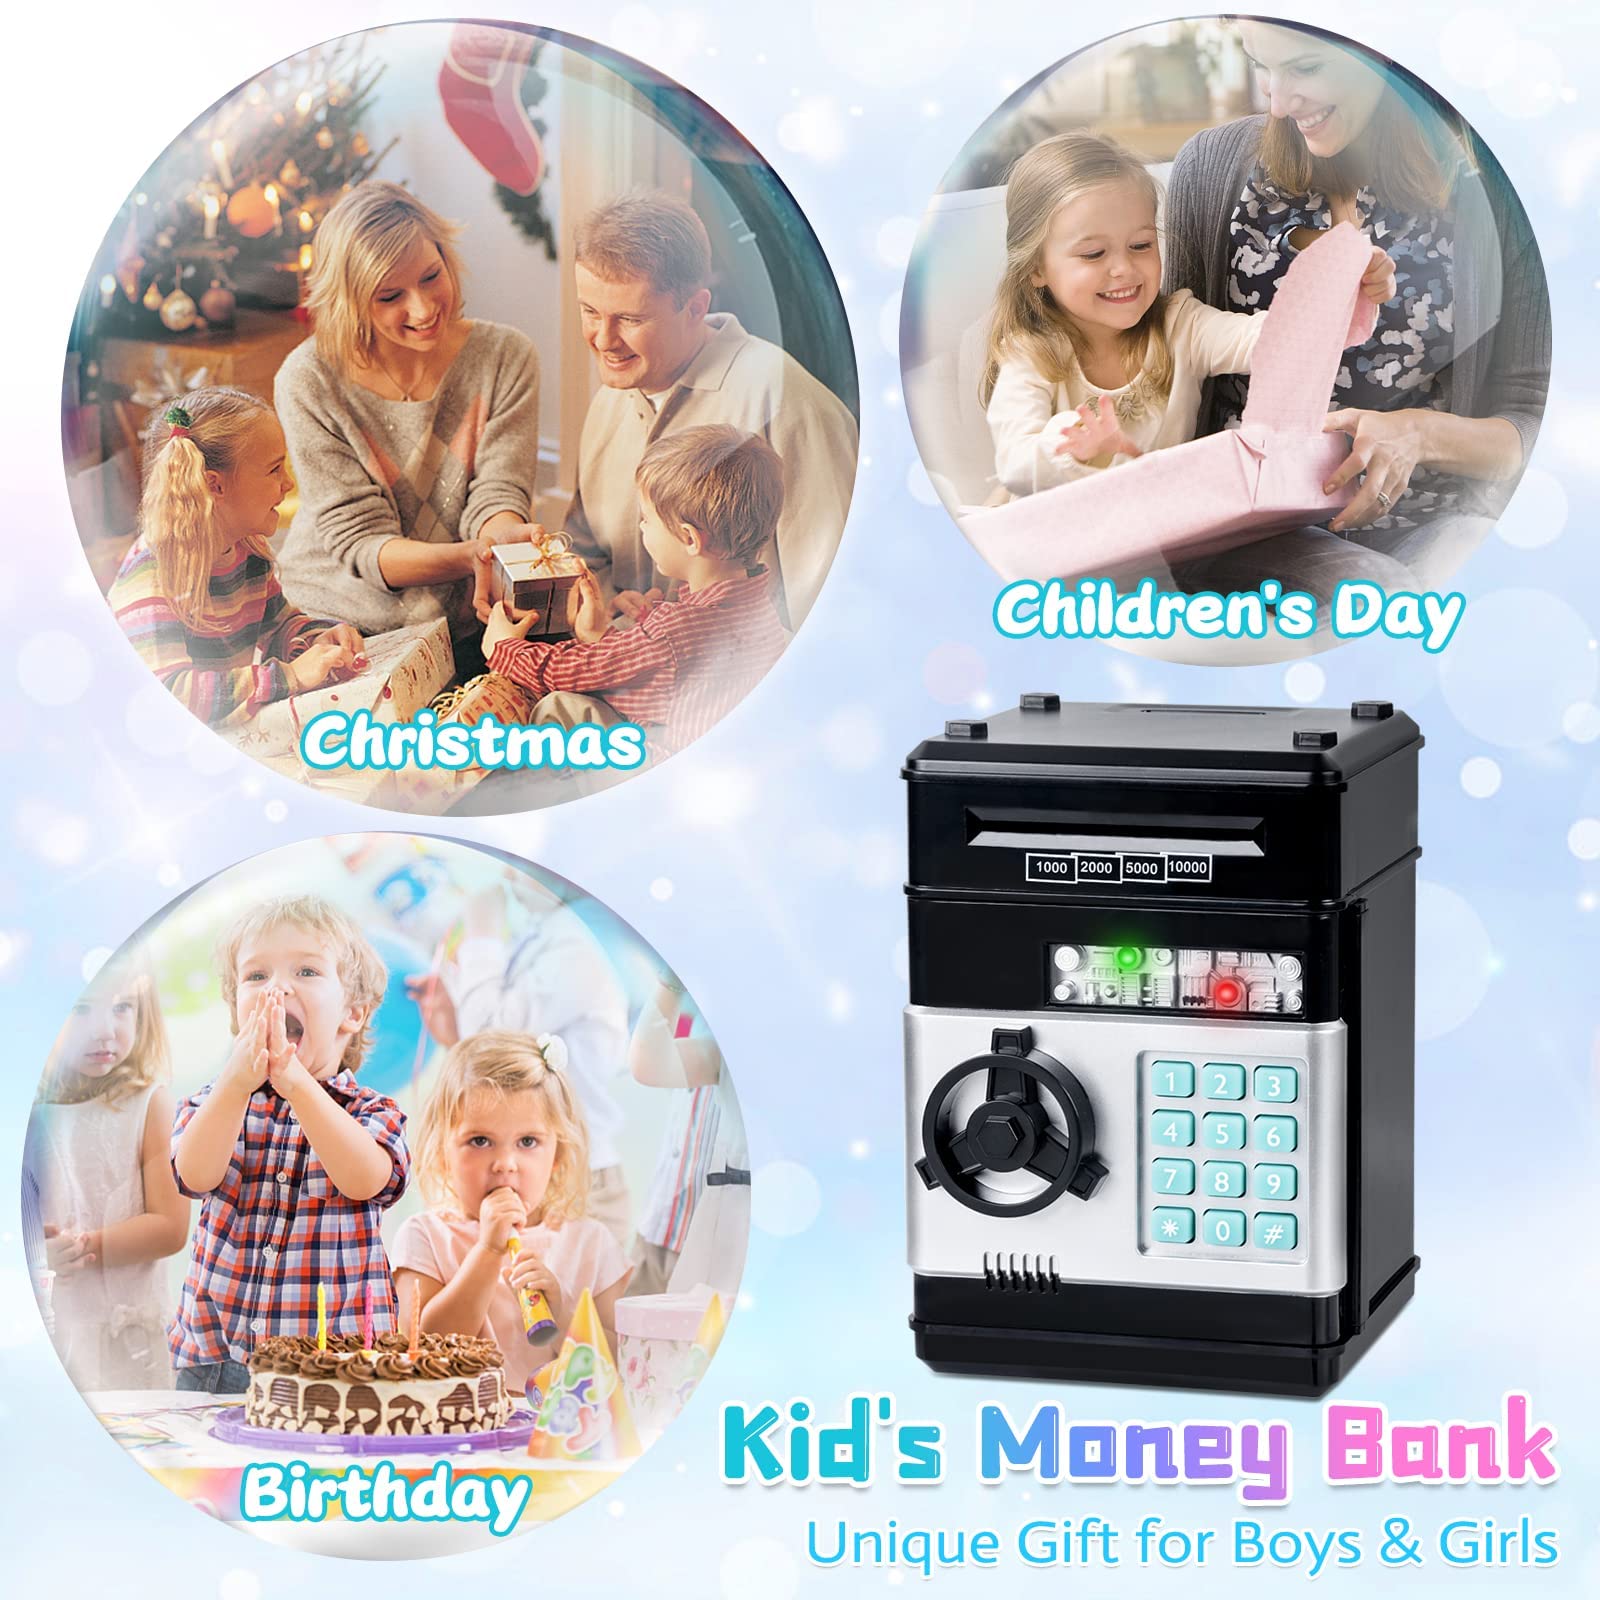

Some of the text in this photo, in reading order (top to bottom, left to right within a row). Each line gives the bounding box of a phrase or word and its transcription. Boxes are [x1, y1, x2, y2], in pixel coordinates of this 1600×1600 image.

[1036, 859, 1208, 876] 1000 2000 5000 10000
[1165, 1072, 1281, 1097] 1 2 3
[1163, 1122, 1281, 1147] 4 5 6
[1163, 1168, 1281, 1194] 7 8 9
[1215, 1221, 1230, 1241] 0
[1264, 1225, 1284, 1244] #
